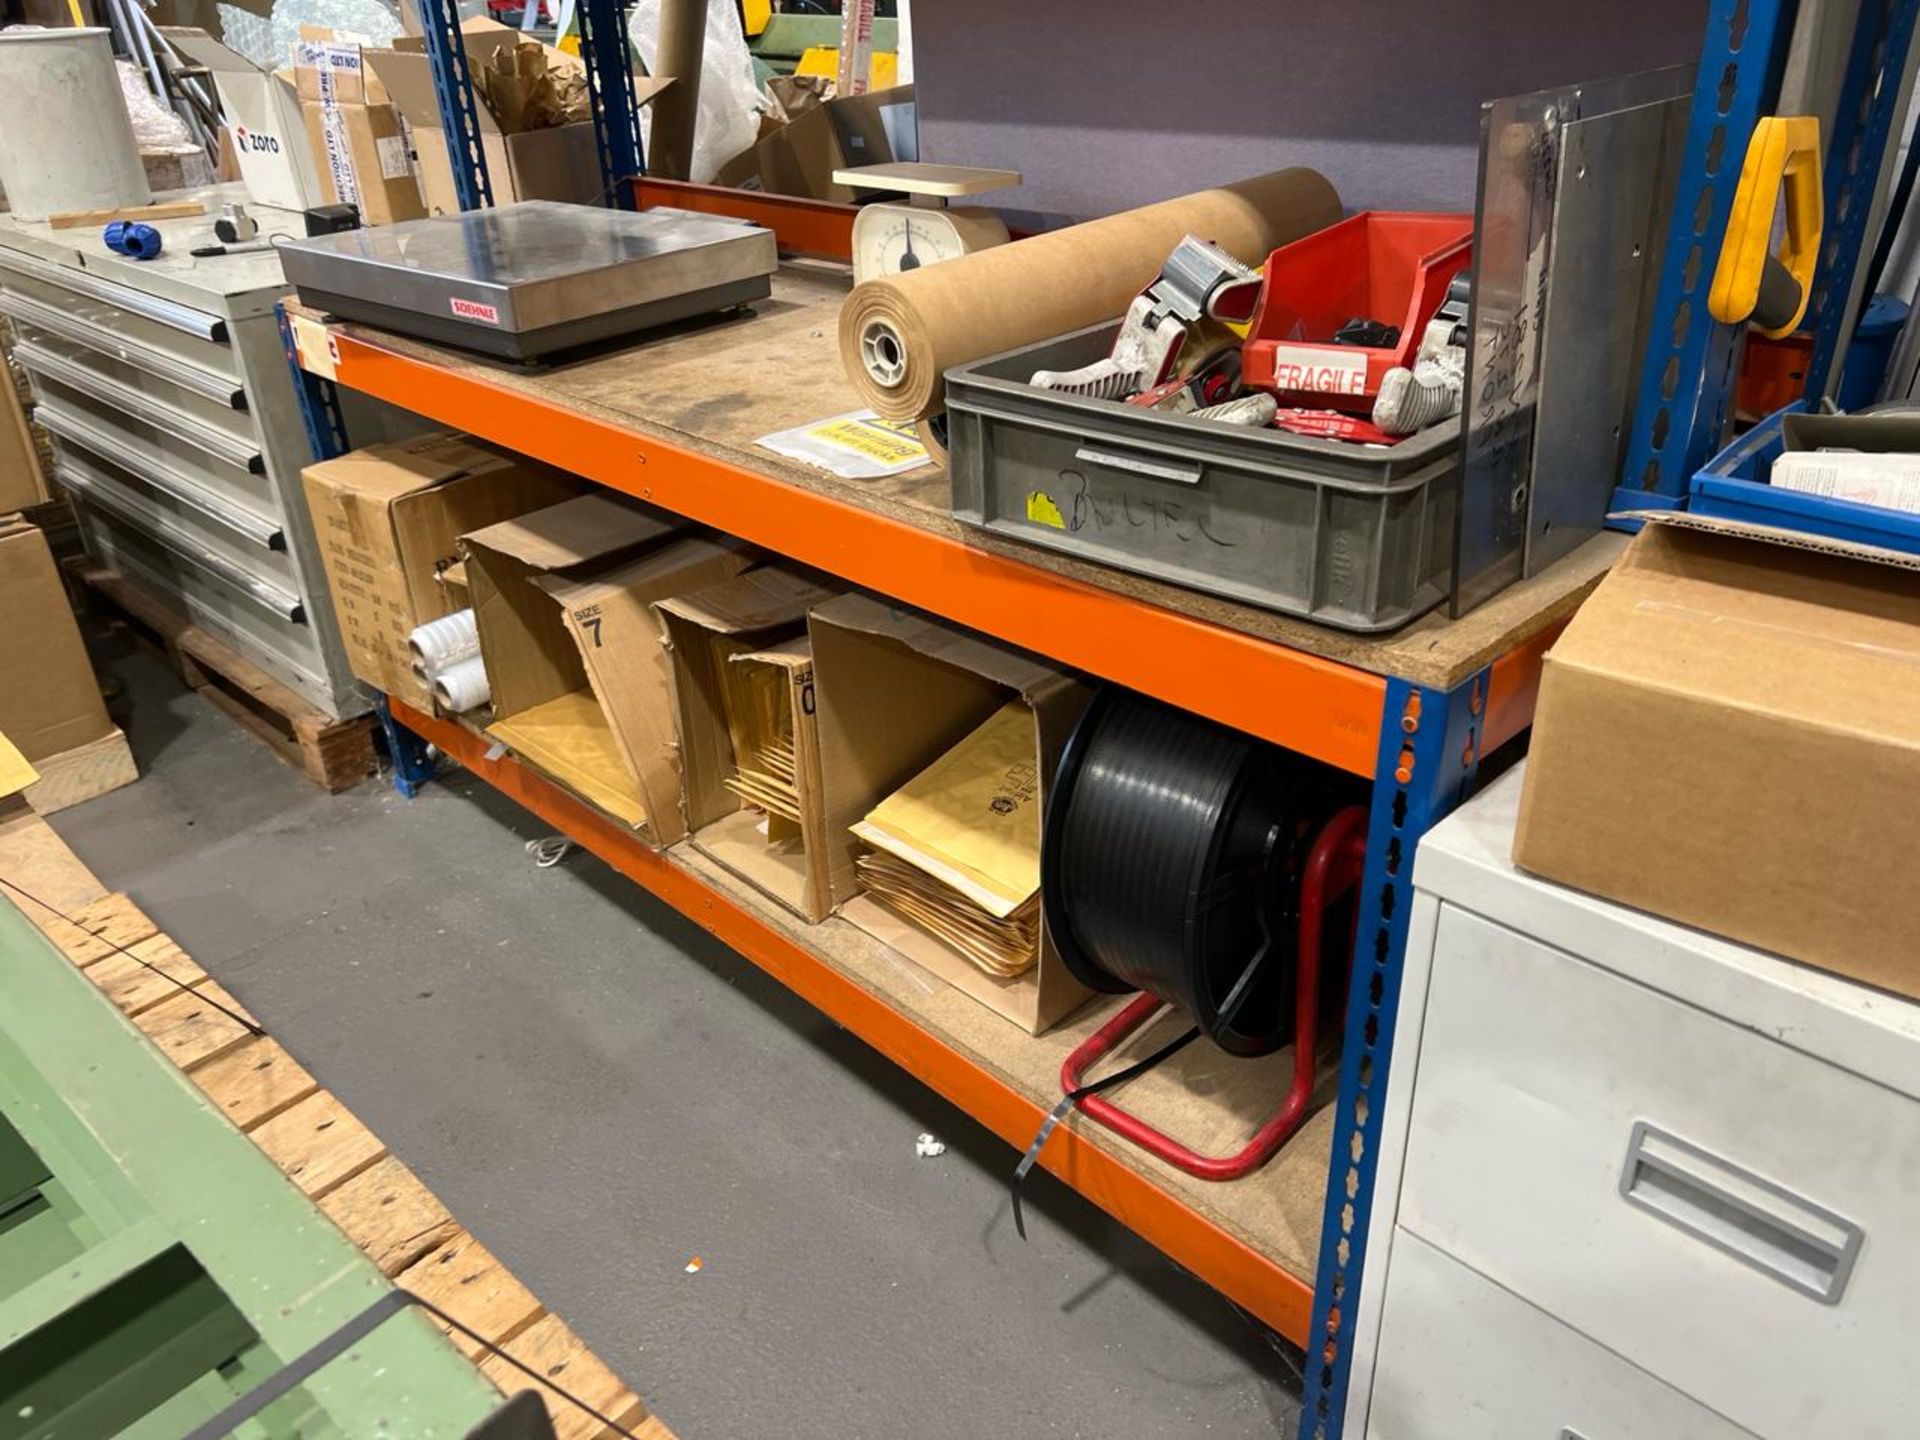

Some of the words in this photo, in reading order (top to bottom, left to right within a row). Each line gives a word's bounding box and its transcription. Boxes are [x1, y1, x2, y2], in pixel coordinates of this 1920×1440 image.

[249, 133, 279, 154] zoro
[453, 301, 495, 320] SOEHNLE
[1277, 363, 1366, 394] FRAGILE
[574, 604, 602, 621] SIZE
[582, 618, 602, 648] 7
[802, 684, 816, 716] 0
